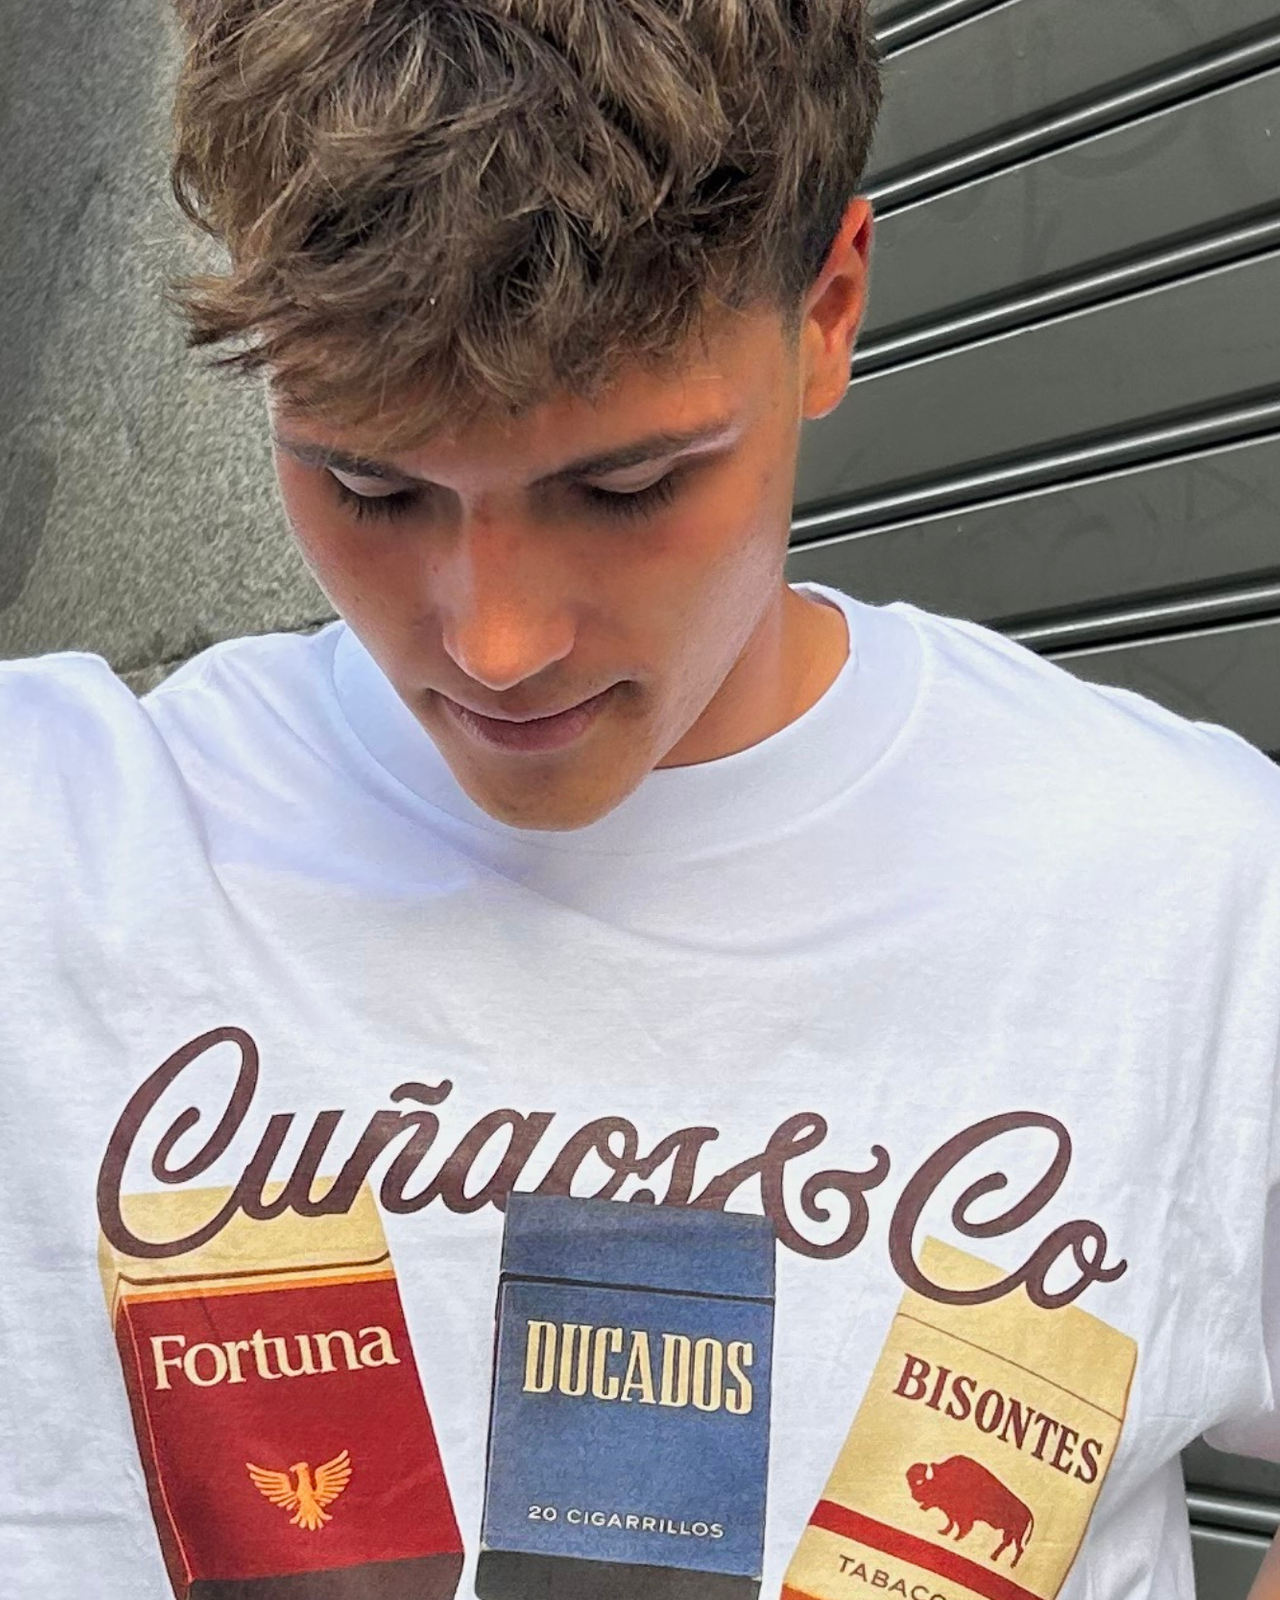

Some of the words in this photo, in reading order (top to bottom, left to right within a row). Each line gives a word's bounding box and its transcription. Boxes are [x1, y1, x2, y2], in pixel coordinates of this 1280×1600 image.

[149, 1325, 401, 1391] Fortuna
[522, 1319, 754, 1416] DUCADOS
[892, 1352, 1104, 1485] BISONTES
[528, 1505, 557, 1522] 20
[567, 1508, 724, 1538] CIGARRILLOS
